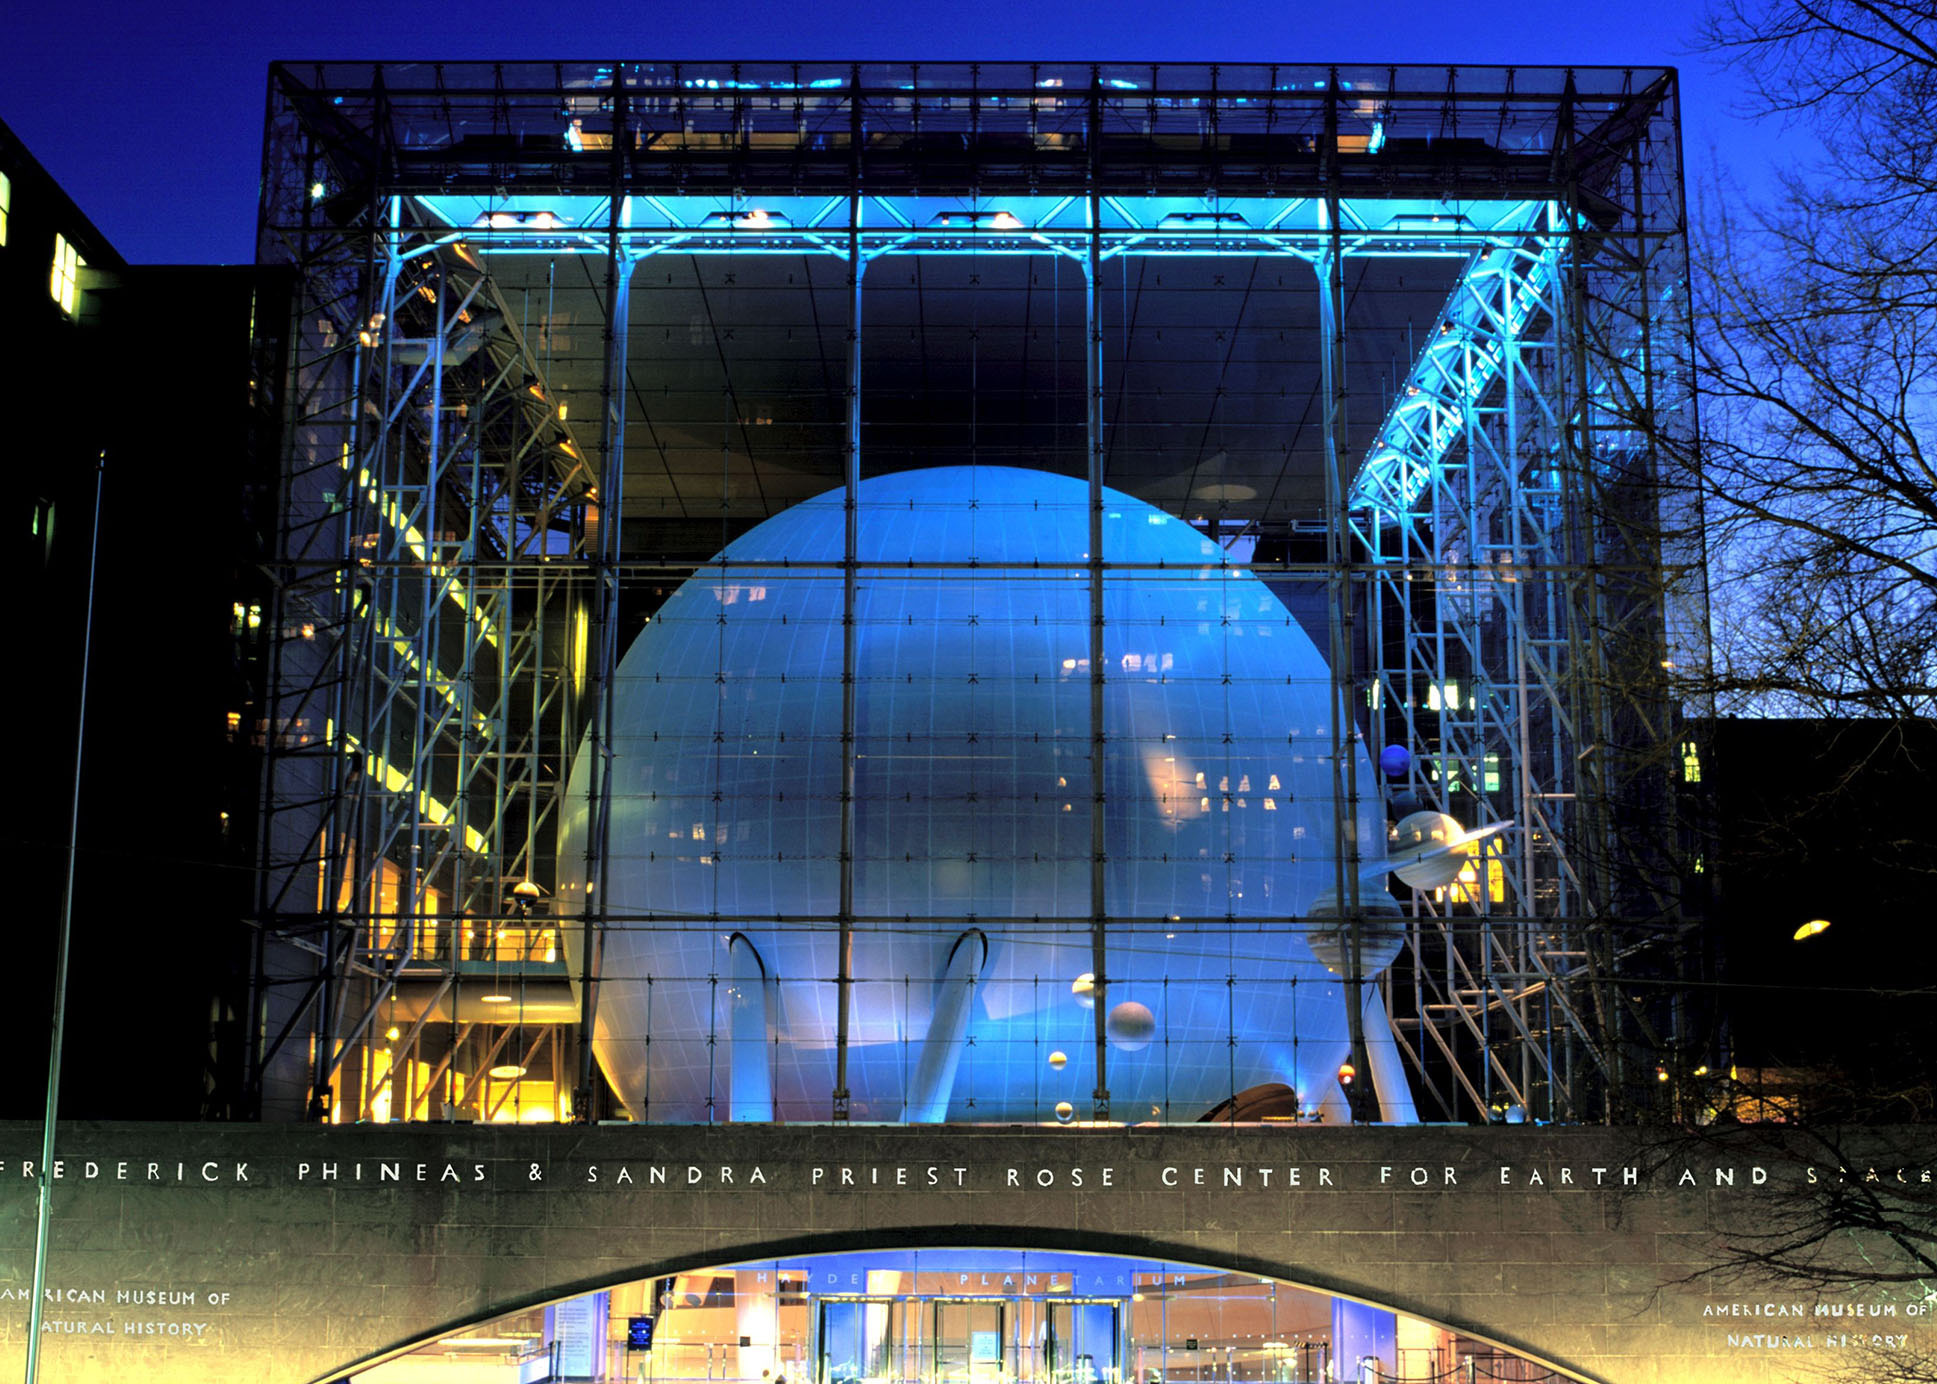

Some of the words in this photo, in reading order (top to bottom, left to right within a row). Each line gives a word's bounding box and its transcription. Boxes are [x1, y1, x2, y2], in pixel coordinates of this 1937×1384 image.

[298, 1162, 485, 1183] PHINEAS
[528, 1162, 543, 1182] &
[587, 1165, 767, 1185] SANDRA
[812, 1166, 967, 1186] PRIEST
[1007, 1167, 1114, 1187] ROSE
[1161, 1166, 1334, 1187] CENTER
[1380, 1166, 1458, 1186] FOR
[1500, 1166, 1638, 1186] EARTH
[1678, 1166, 1768, 1187] AND
[757, 1272, 884, 1285] HAYDEN
[959, 1274, 1186, 1286] PLANETARIUM
[1, 1288, 105, 1303] AMRICAN
[117, 1290, 195, 1305] MUSEUM
[208, 1292, 231, 1305] OF
[1703, 1303, 1804, 1317] AMERICAN
[1815, 1303, 1896, 1317] MUSEUM
[1906, 1304, 1928, 1316] OF
[41, 1321, 115, 1334] ATURAL
[124, 1322, 207, 1336] HISTORY
[1727, 1334, 1813, 1348] NATURAL
